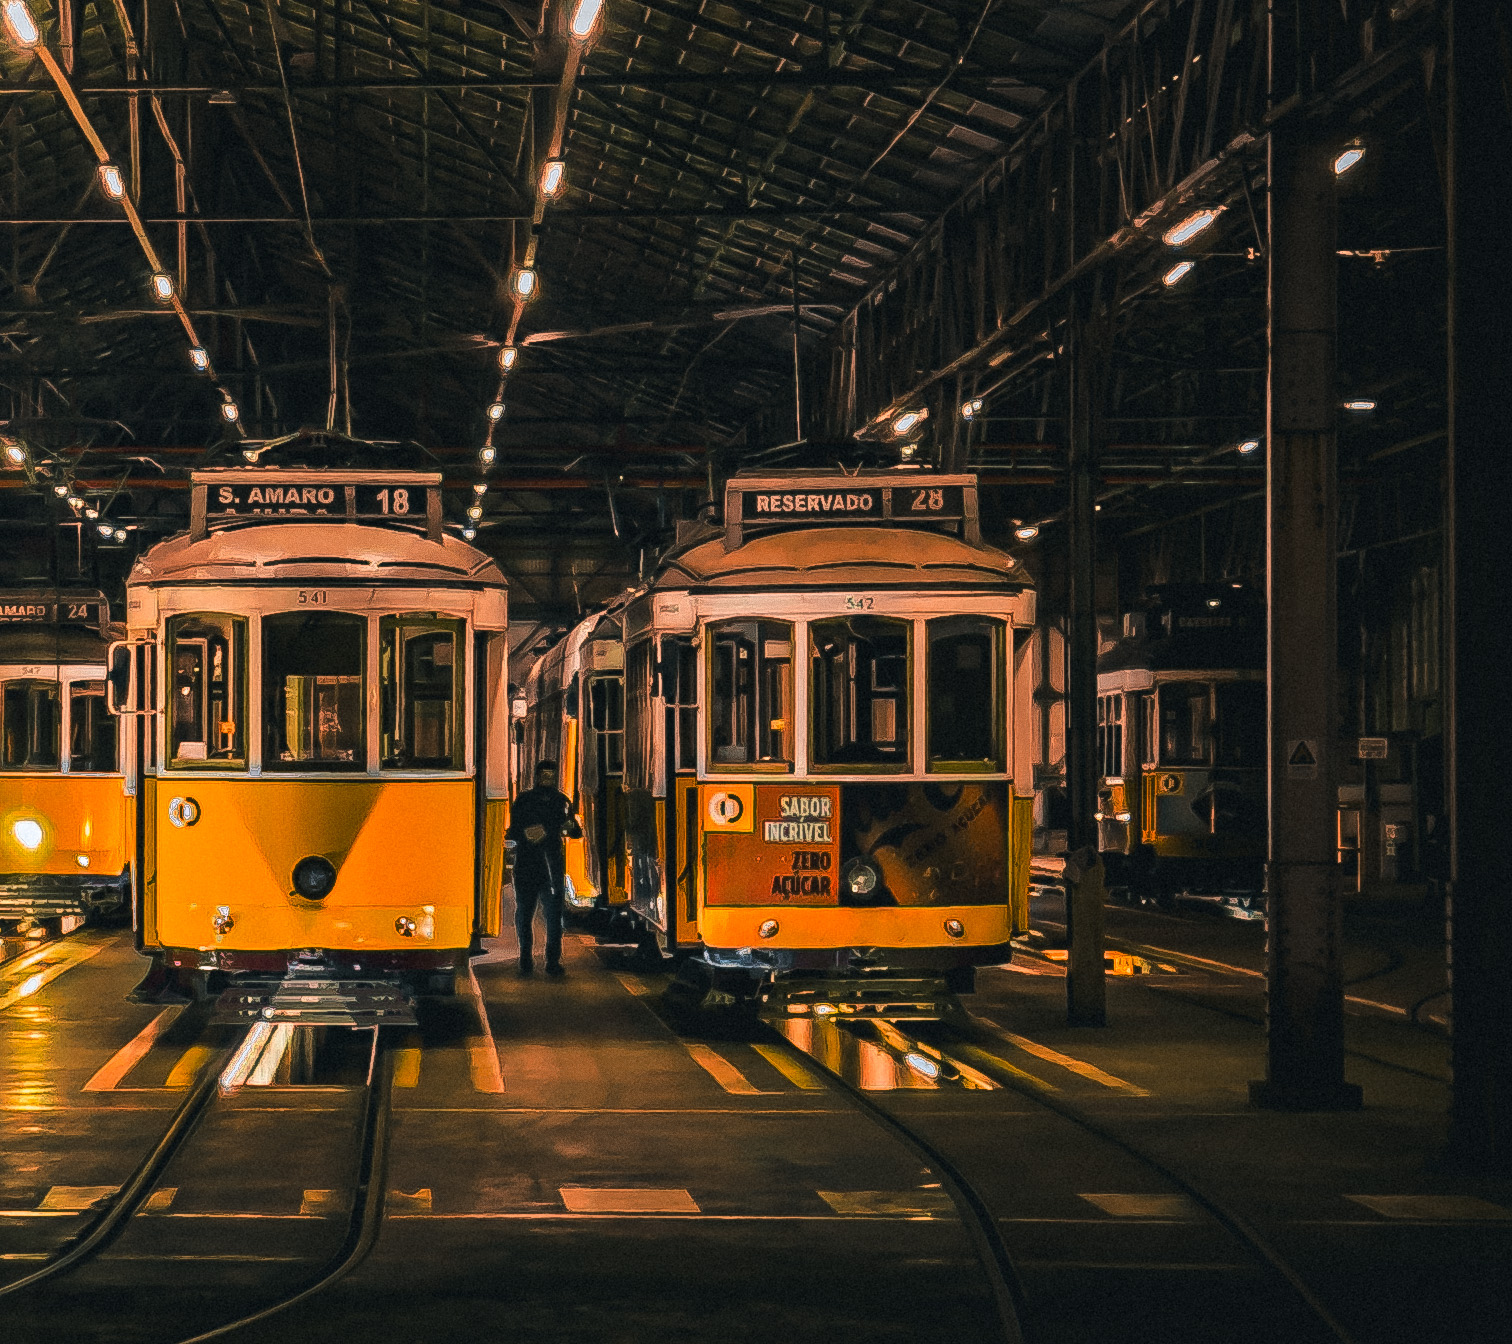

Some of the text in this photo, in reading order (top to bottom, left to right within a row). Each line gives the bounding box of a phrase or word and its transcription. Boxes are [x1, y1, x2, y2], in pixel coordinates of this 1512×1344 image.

[218, 486, 335, 504] S. AMARO
[376, 488, 410, 515] 18
[756, 494, 873, 512] RESERVADO
[911, 488, 944, 510] 28
[297, 590, 327, 605] 541
[845, 597, 874, 611] 542
[68, 603, 88, 619] 24
[780, 796, 832, 818] SABOR
[763, 817, 833, 843] INCRÍVEL
[791, 851, 832, 870] ZERO
[771, 869, 831, 897] AÇÚCAR
